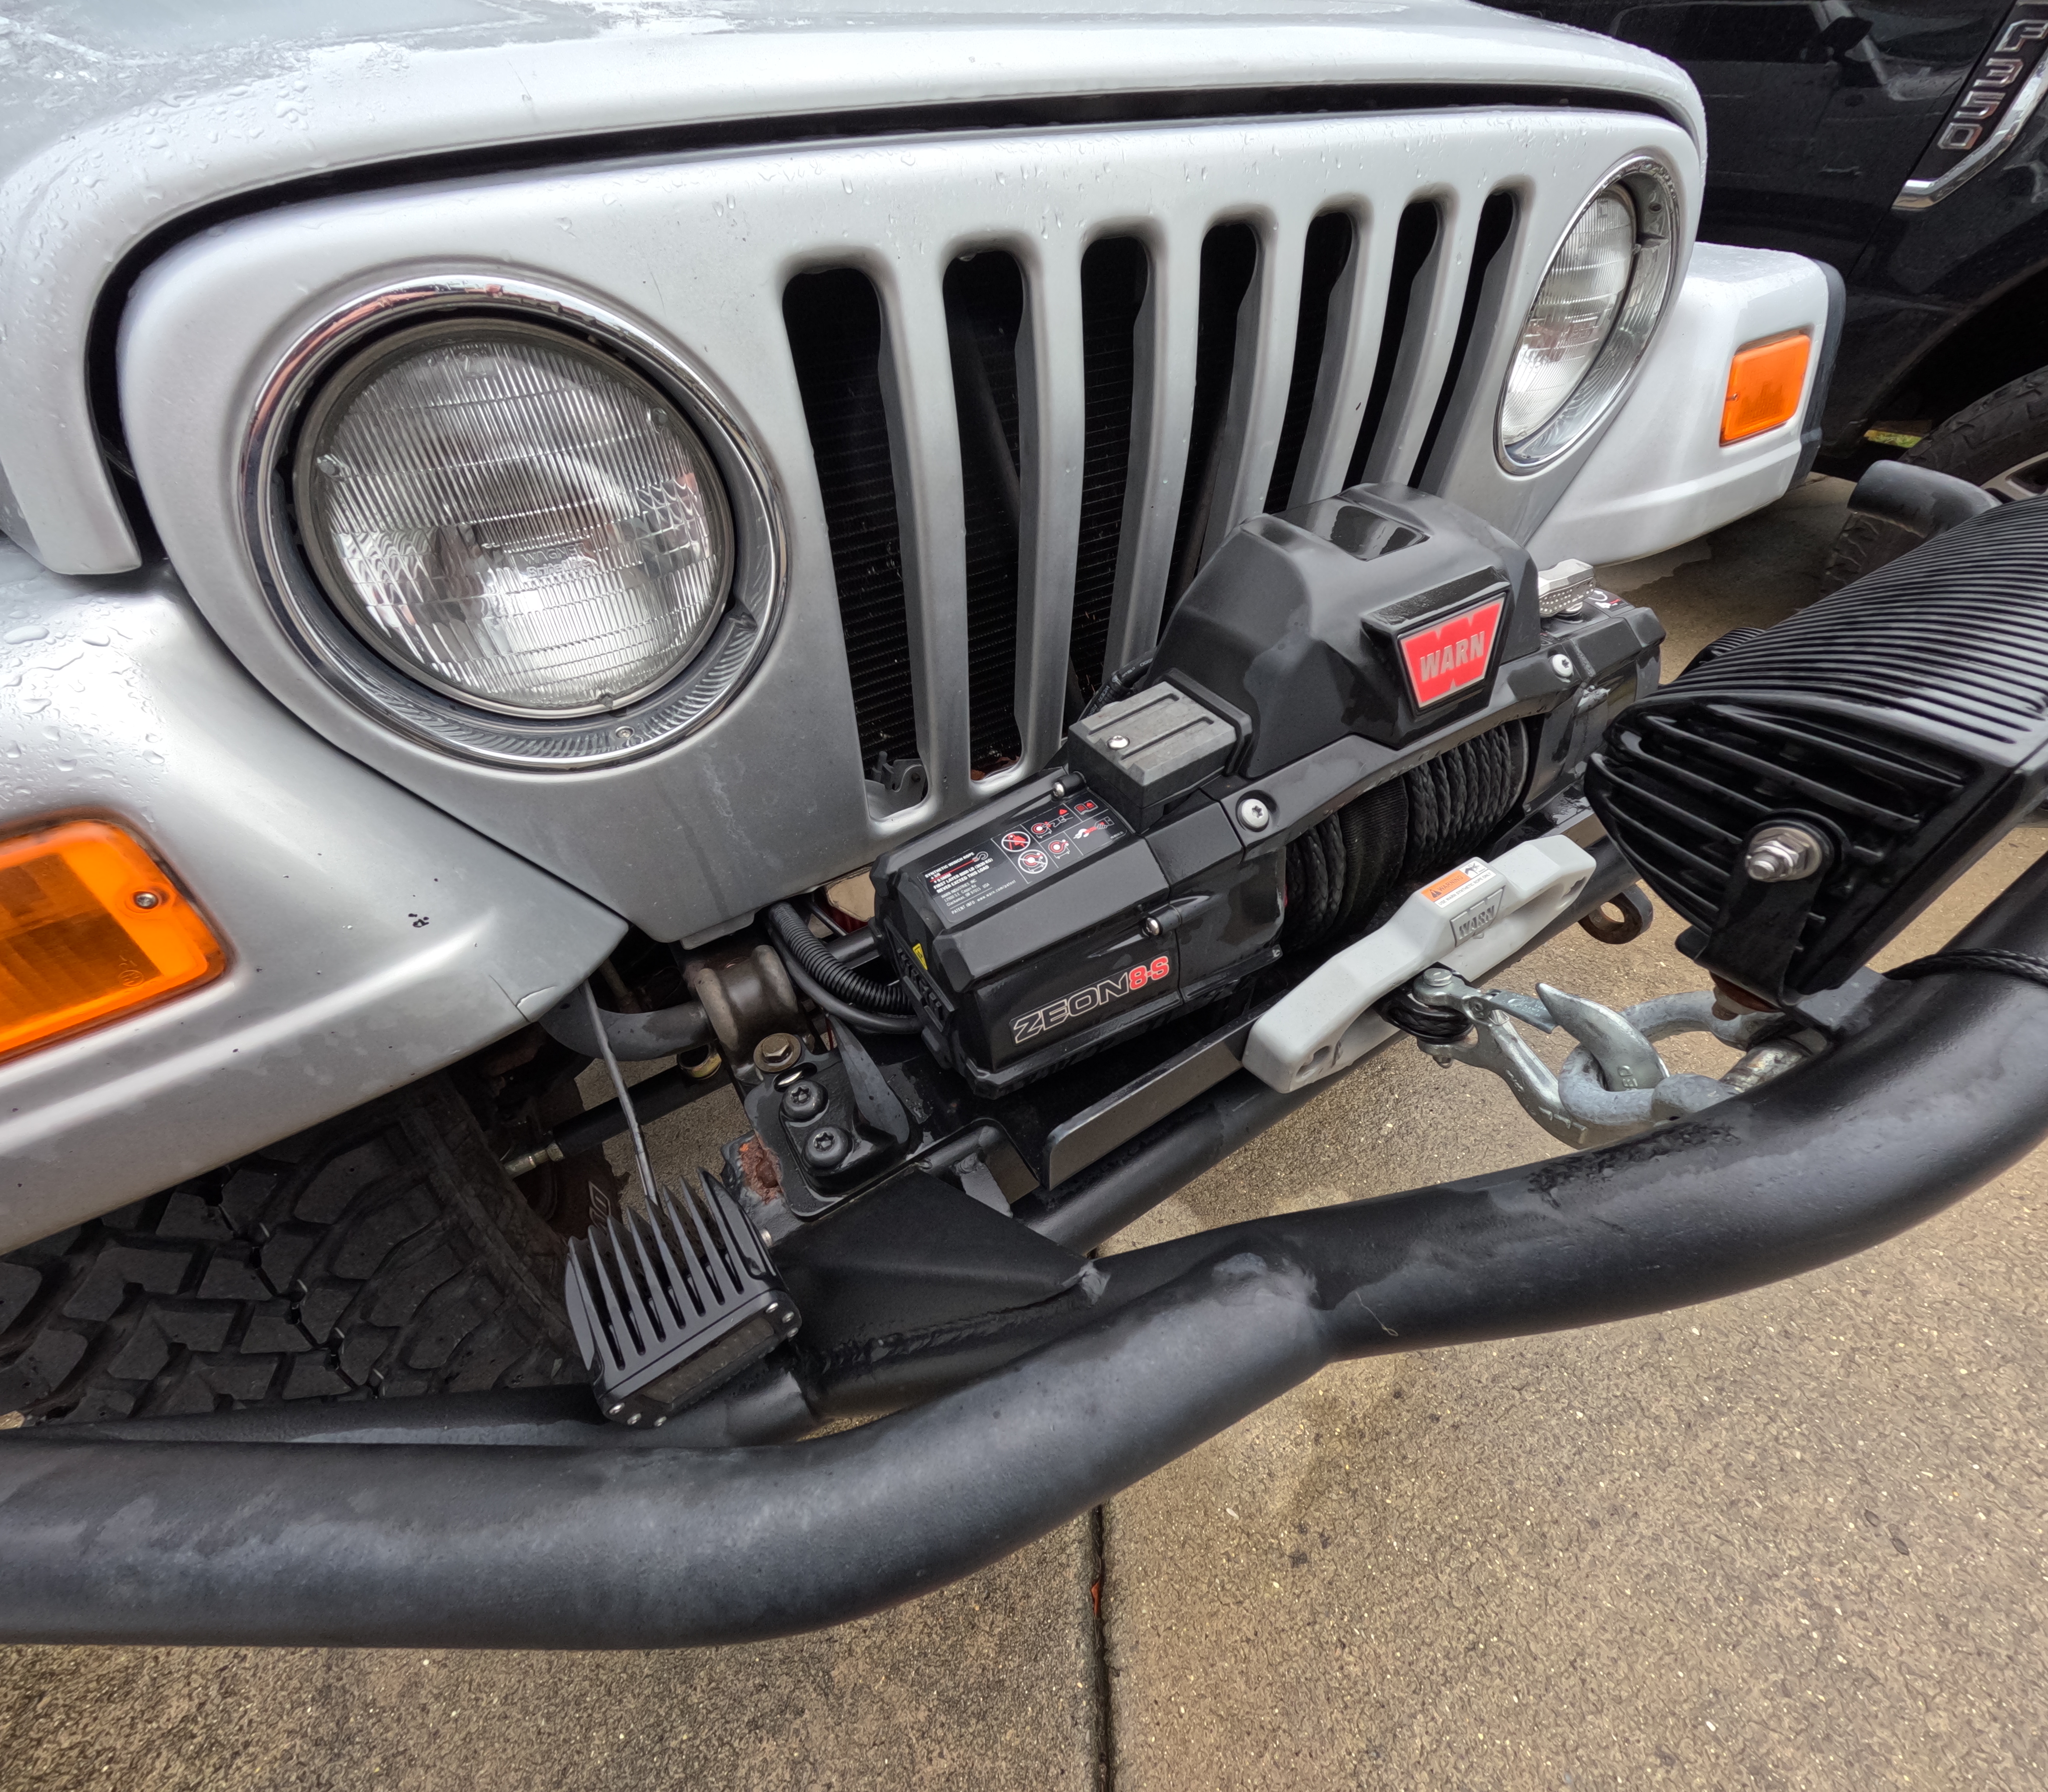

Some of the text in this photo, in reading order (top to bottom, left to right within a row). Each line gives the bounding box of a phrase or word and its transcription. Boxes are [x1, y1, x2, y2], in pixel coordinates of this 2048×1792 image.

[520, 543, 587, 565] WAGNER
[1420, 630, 1485, 682] WARN
[925, 865, 948, 878] SYNTHETIC
[948, 857, 963, 866] WINCH
[936, 885, 952, 893] NEVER
[951, 877, 967, 886] EXCEED
[977, 865, 989, 873] LOAD
[946, 875, 959, 885] LAYER
[1437, 875, 1464, 891] WARNING
[1455, 882, 1475, 895] SYNTHETIC
[1473, 877, 1483, 885] ROPE
[951, 906, 965, 914] PATENT
[1013, 972, 1129, 1044] ZEON
